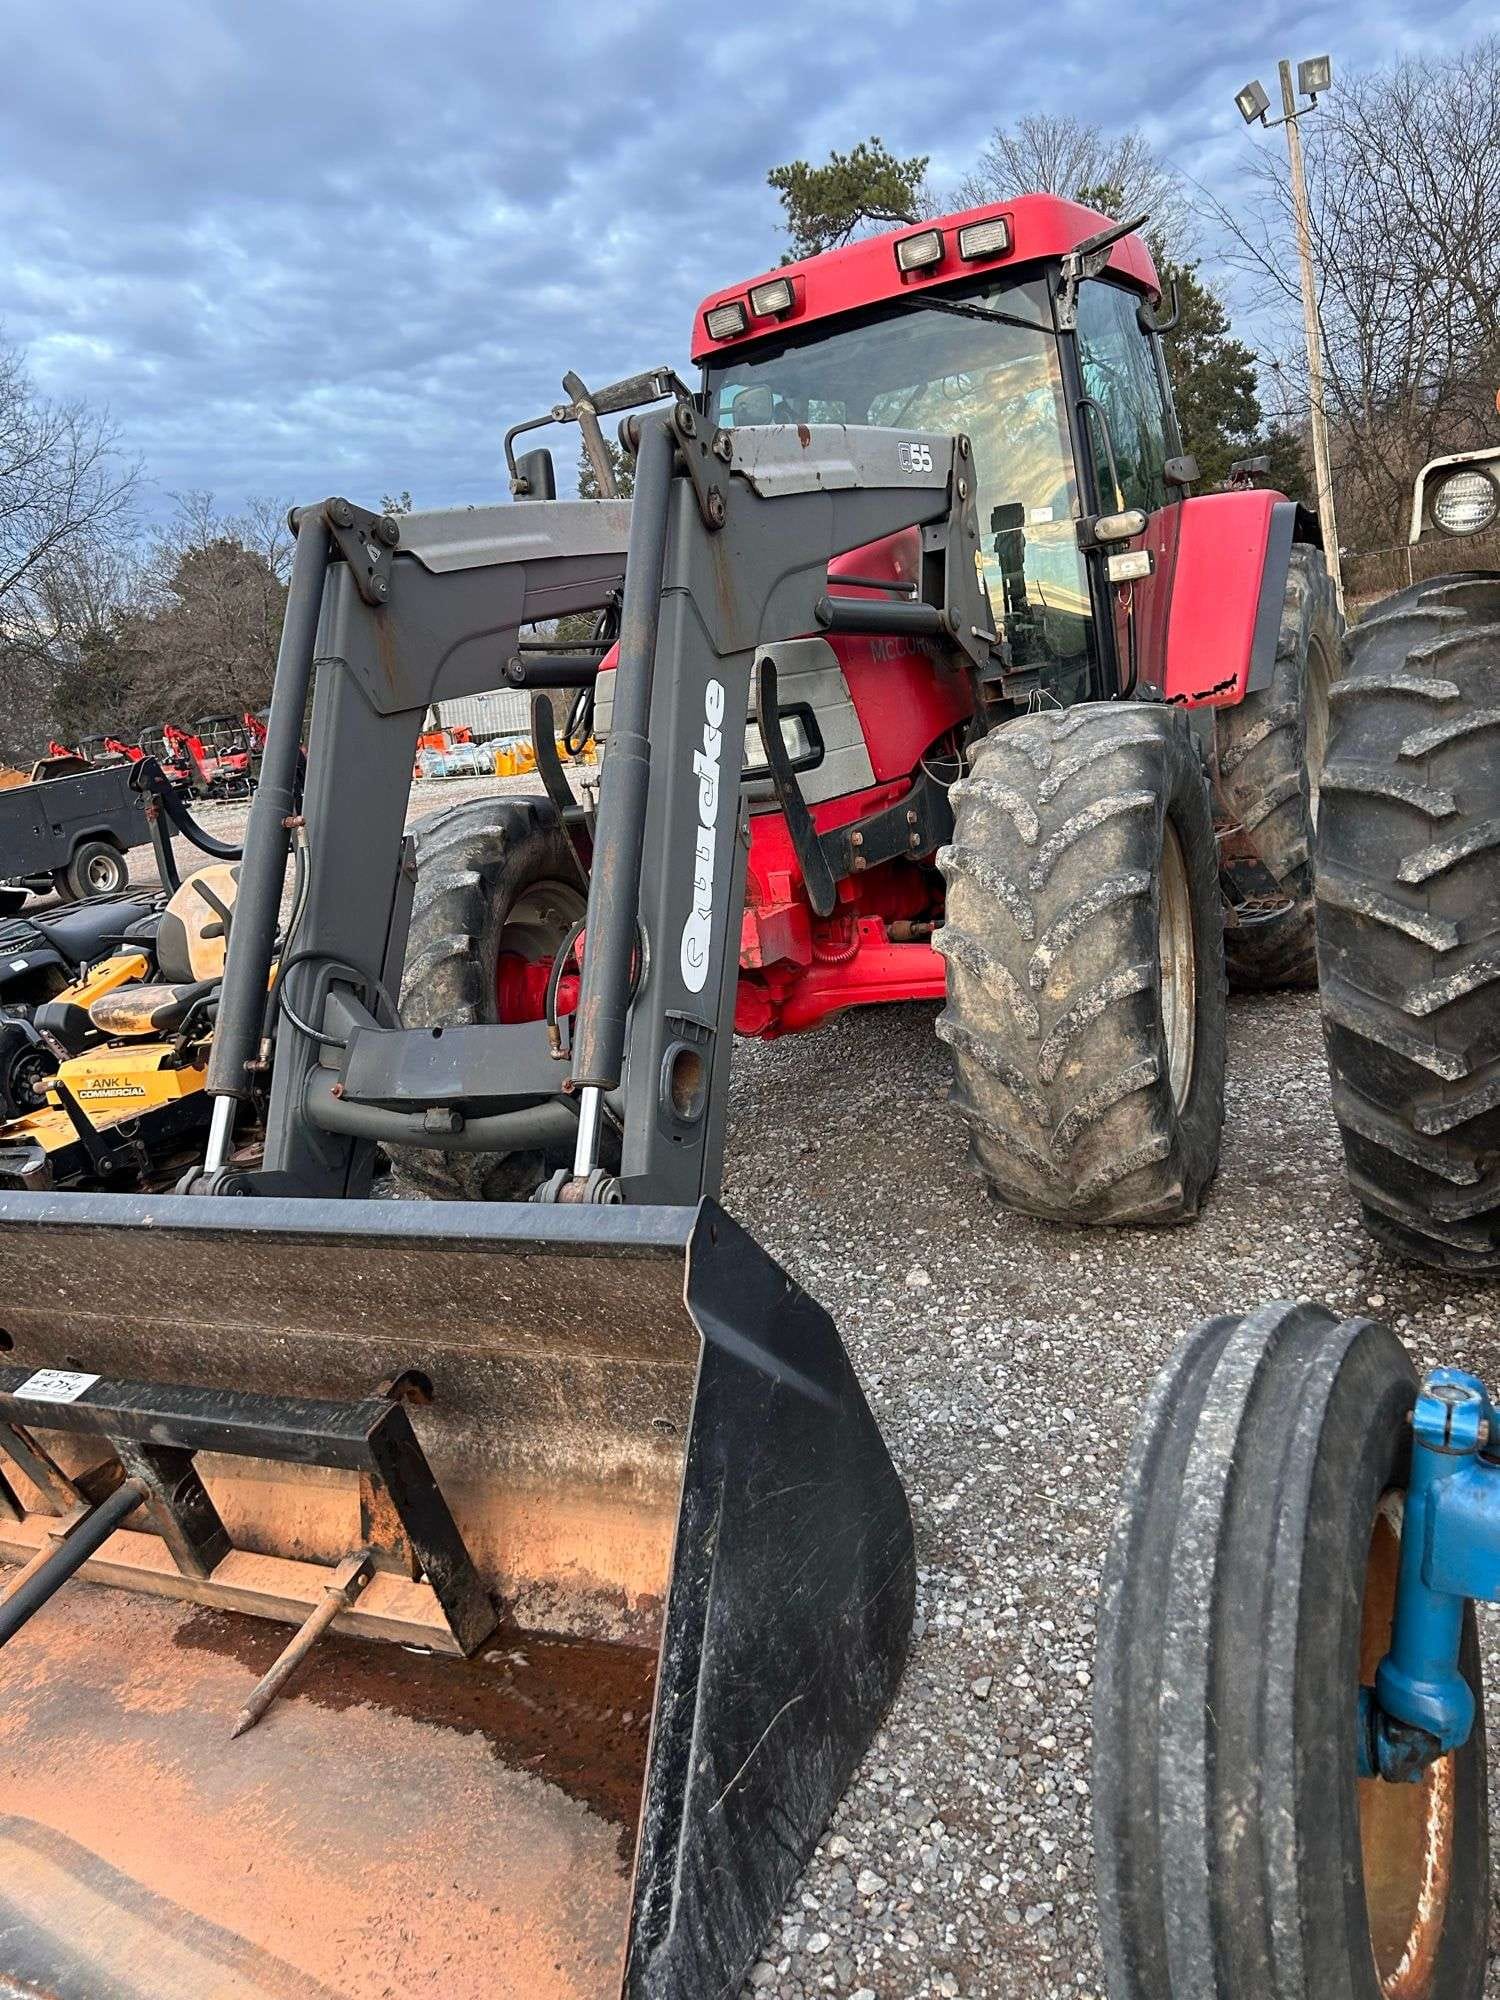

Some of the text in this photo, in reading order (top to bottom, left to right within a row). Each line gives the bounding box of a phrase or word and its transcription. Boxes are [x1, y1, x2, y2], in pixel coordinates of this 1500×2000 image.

[897, 441, 933, 474] Q55
[680, 678, 725, 994] Quicke
[79, 1087, 145, 1099] COMMERCIAL
